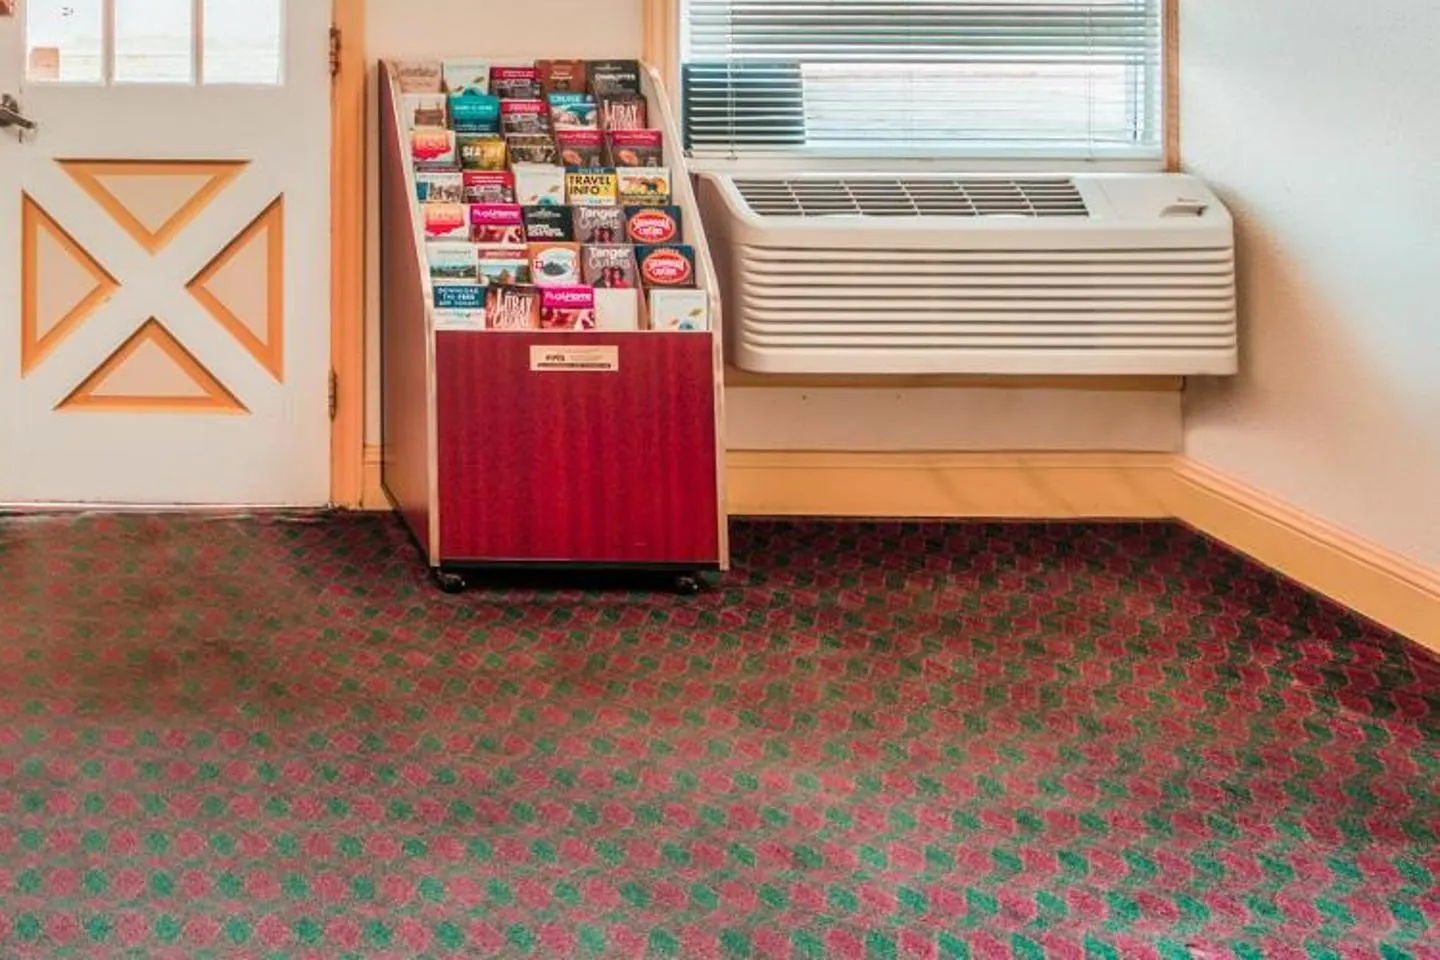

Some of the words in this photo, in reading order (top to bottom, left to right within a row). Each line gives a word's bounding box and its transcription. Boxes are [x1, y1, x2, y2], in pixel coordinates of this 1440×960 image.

[569, 175, 611, 185] TRAVEL
[569, 185, 600, 195] INFO
[579, 207, 620, 220] Tanger
[588, 246, 631, 259] Tanger
